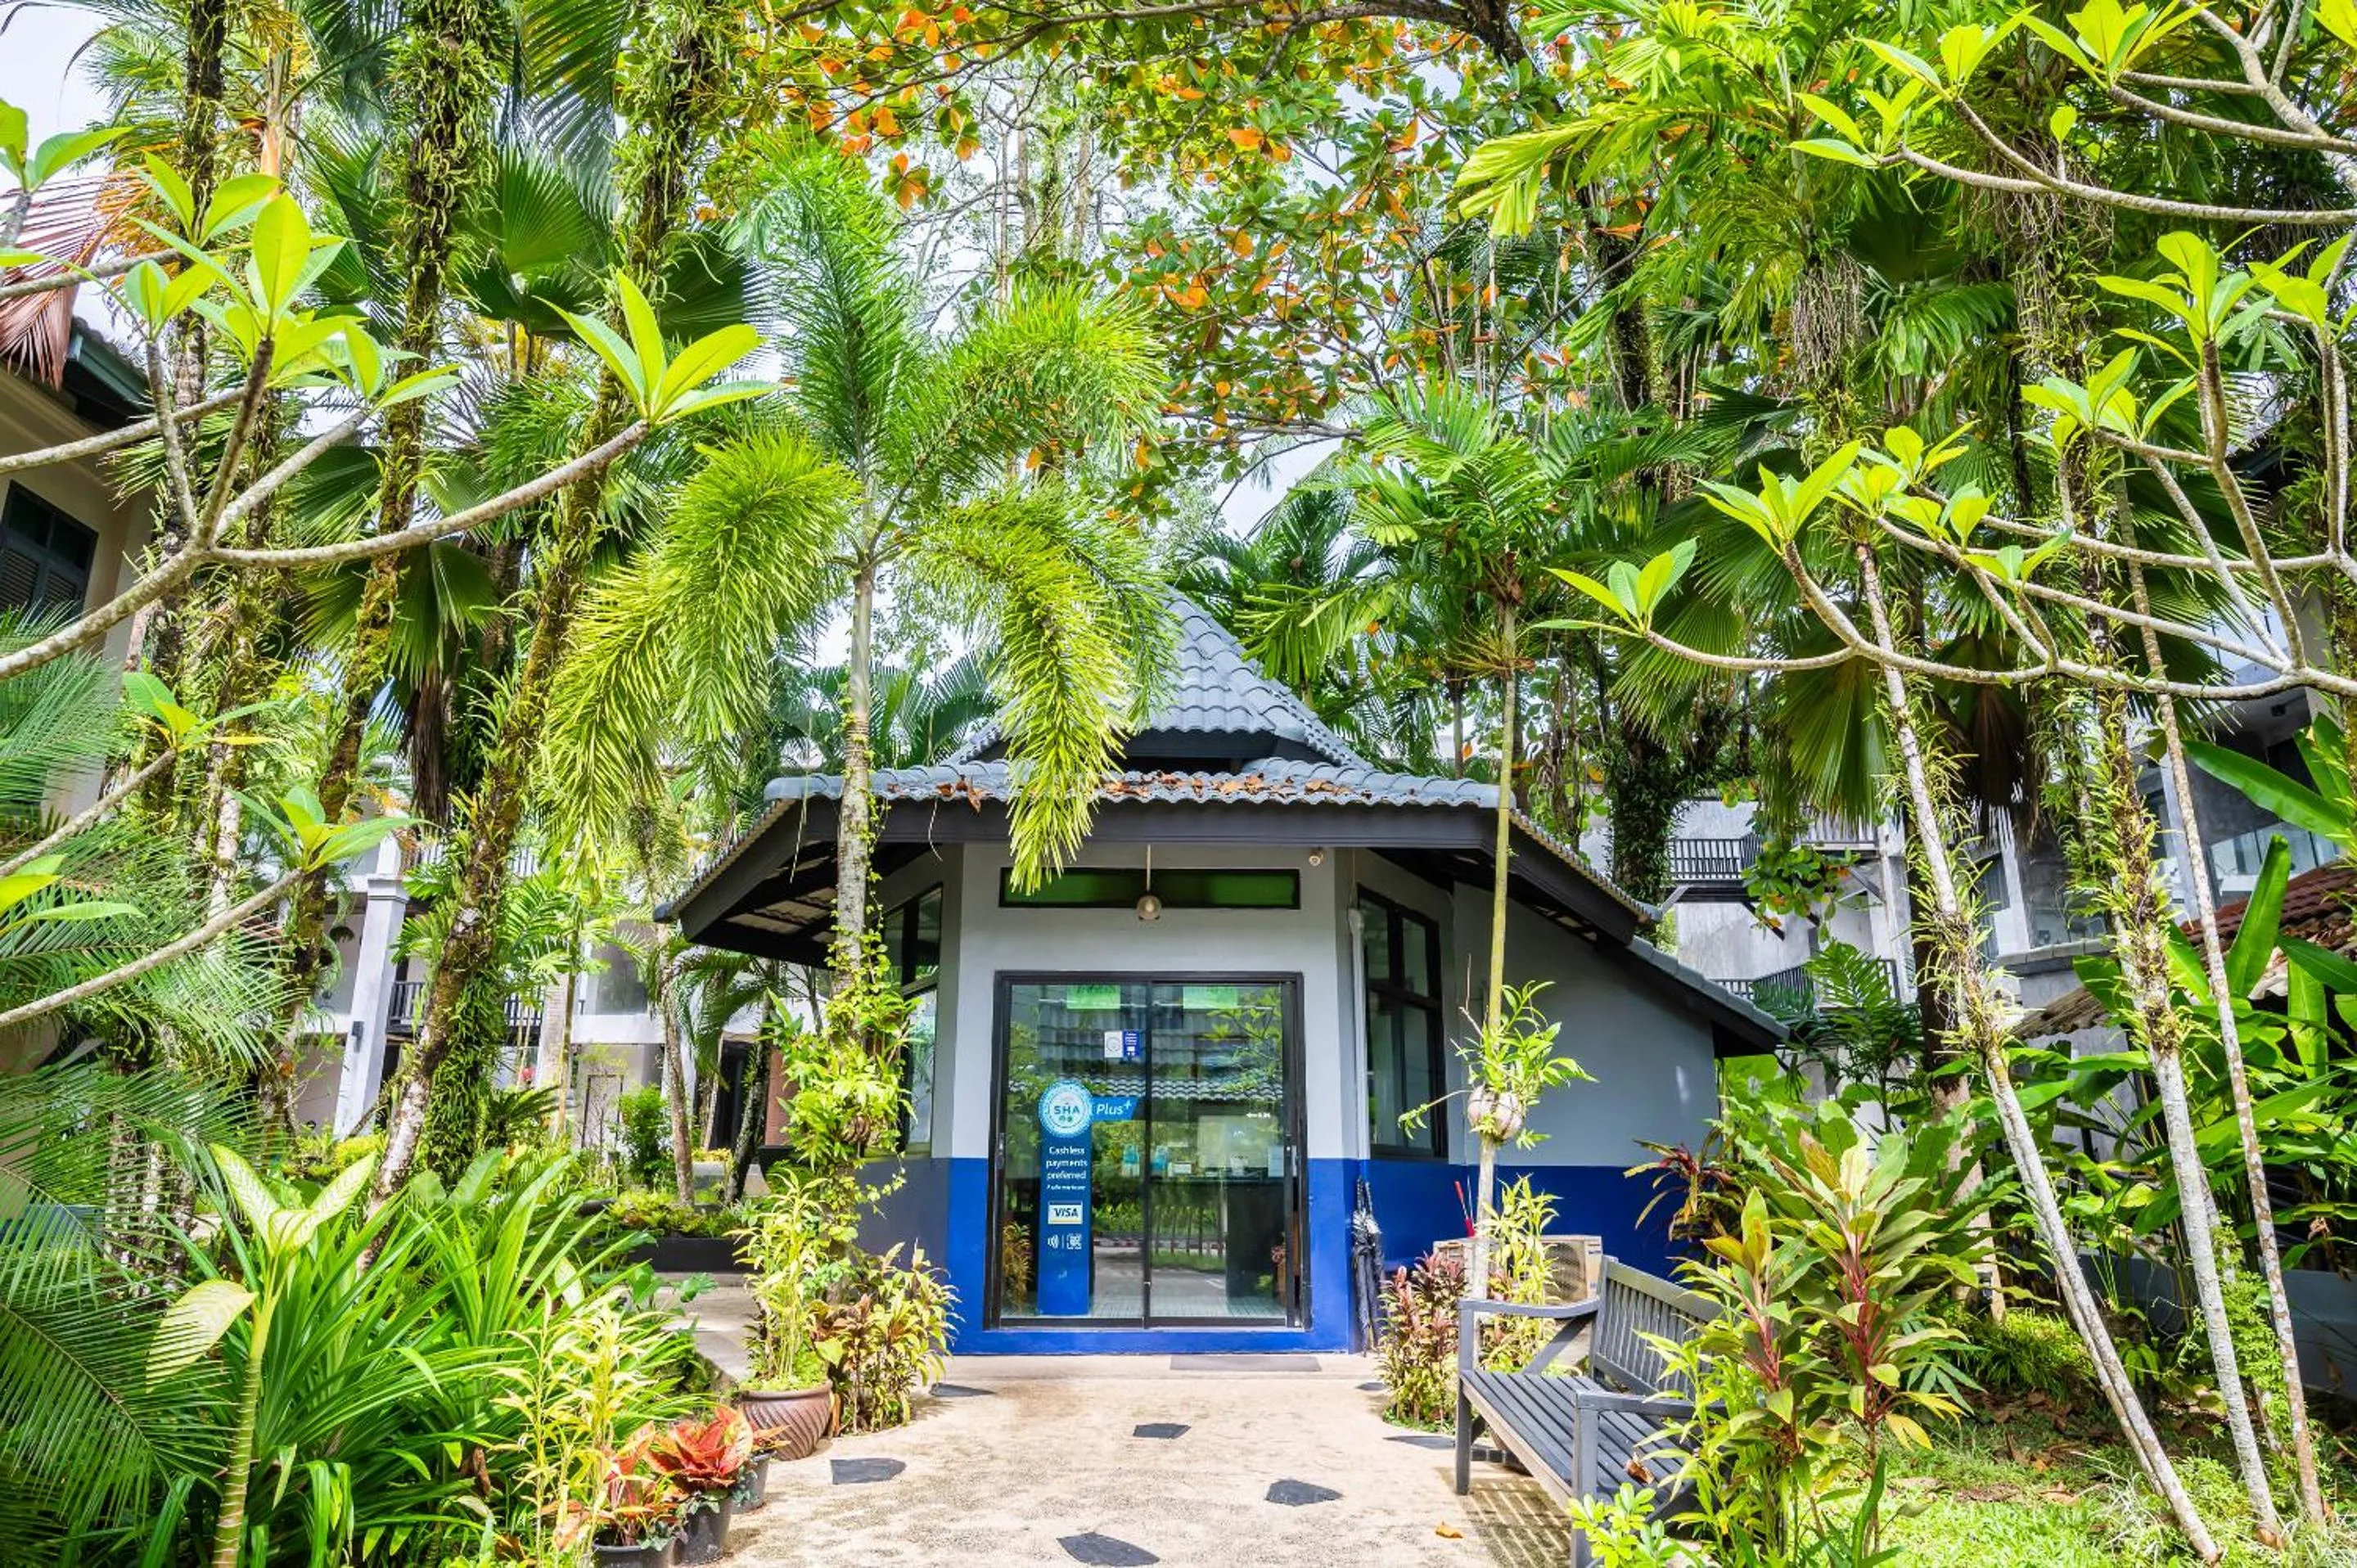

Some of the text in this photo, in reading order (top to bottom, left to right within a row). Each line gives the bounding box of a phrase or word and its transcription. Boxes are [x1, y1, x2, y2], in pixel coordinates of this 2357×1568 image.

[1054, 1106, 1080, 1114] SHA
[1048, 1146, 1085, 1156] Cashless
[1046, 1160, 1088, 1169] payments
[1047, 1170, 1087, 1180] preferred
[1053, 1207, 1079, 1218] VISA
